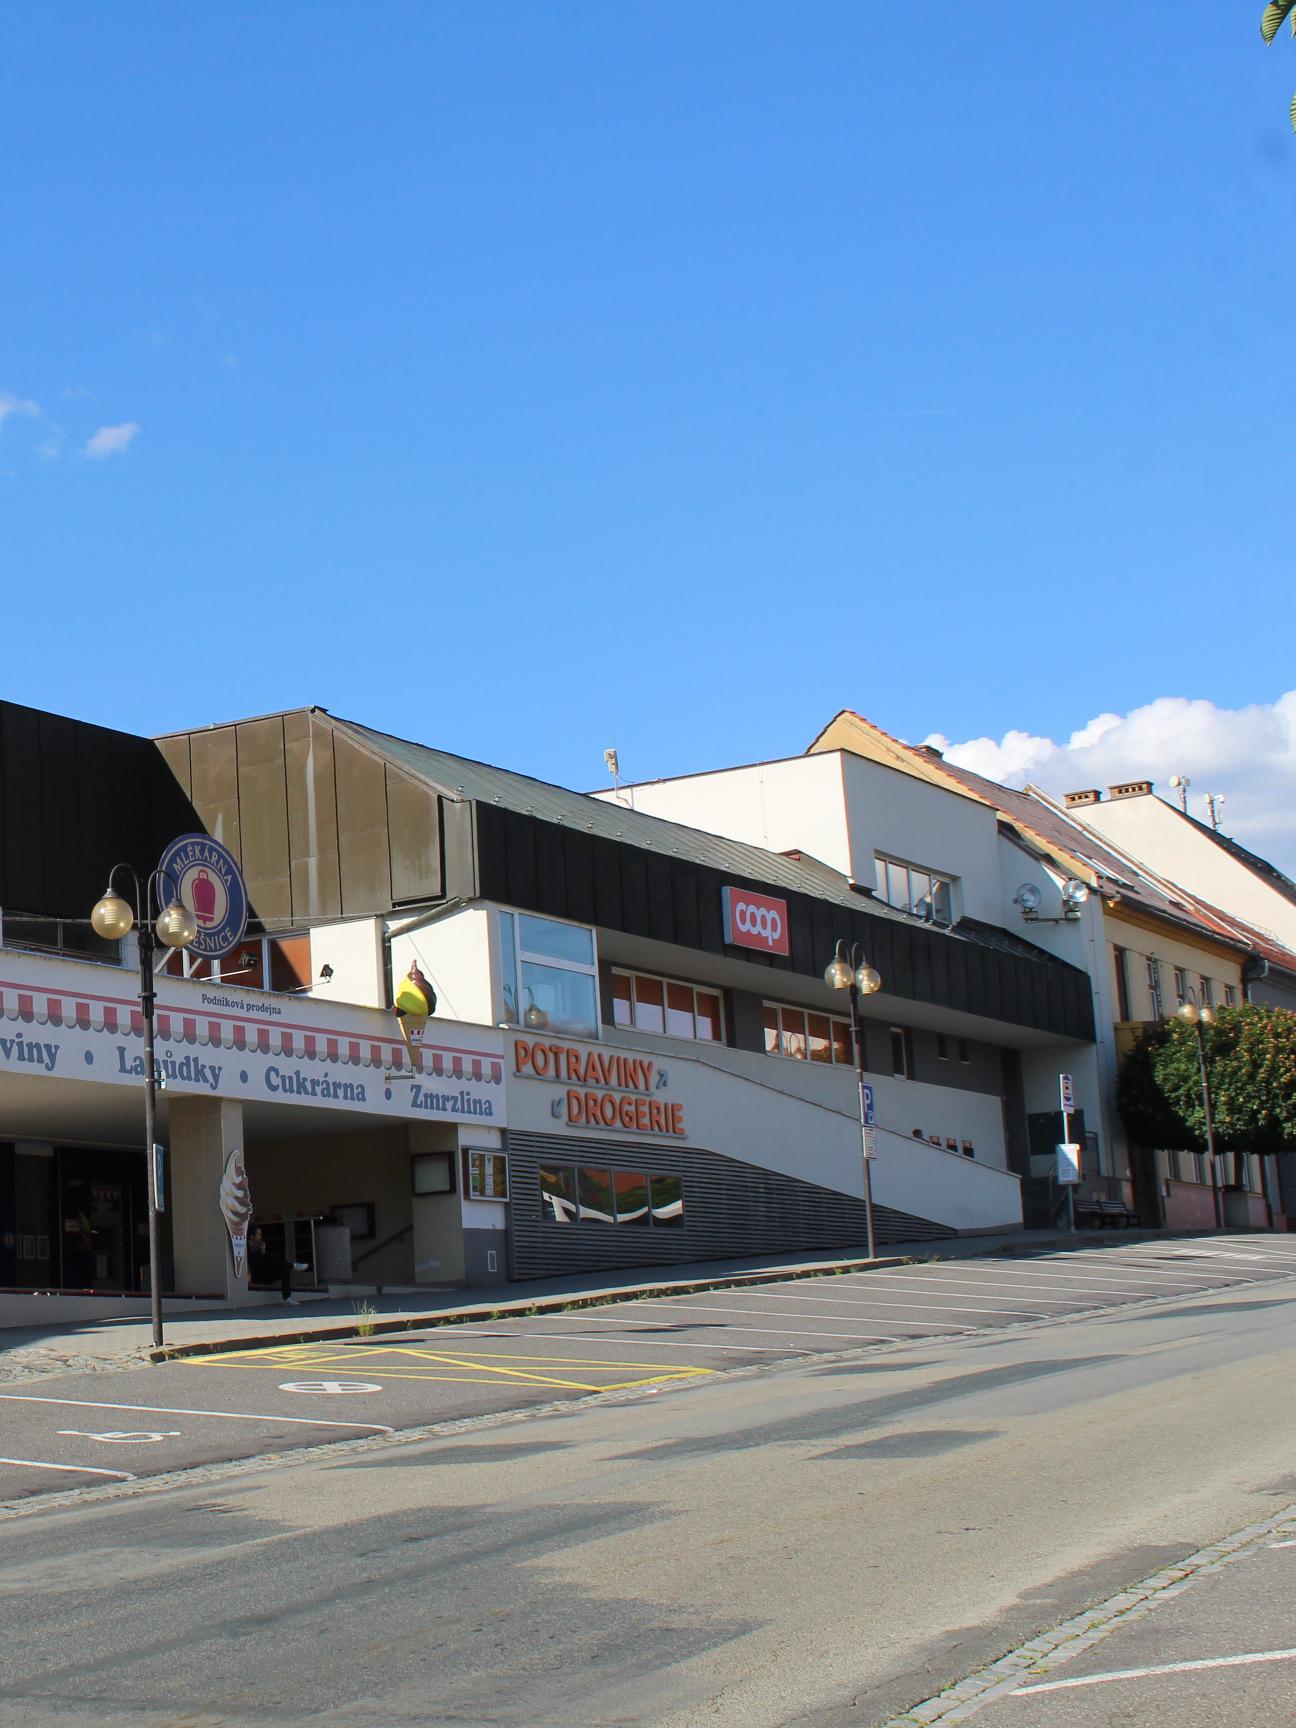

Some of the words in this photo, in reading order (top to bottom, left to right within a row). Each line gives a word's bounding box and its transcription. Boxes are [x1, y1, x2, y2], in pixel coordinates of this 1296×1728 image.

[173, 844, 232, 886] MLÉKÁRNA
[192, 927, 234, 950] EŠNICE
[201, 993, 245, 1010] Podniková
[245, 1002, 282, 1016] prodejna
[116, 1046, 223, 1090] Laůdky
[264, 1065, 367, 1103] Cukrárna
[410, 1084, 494, 1118] Zmrzlina
[514, 1040, 653, 1091] POTRAVINY
[567, 1089, 685, 1135] DROGERIE
